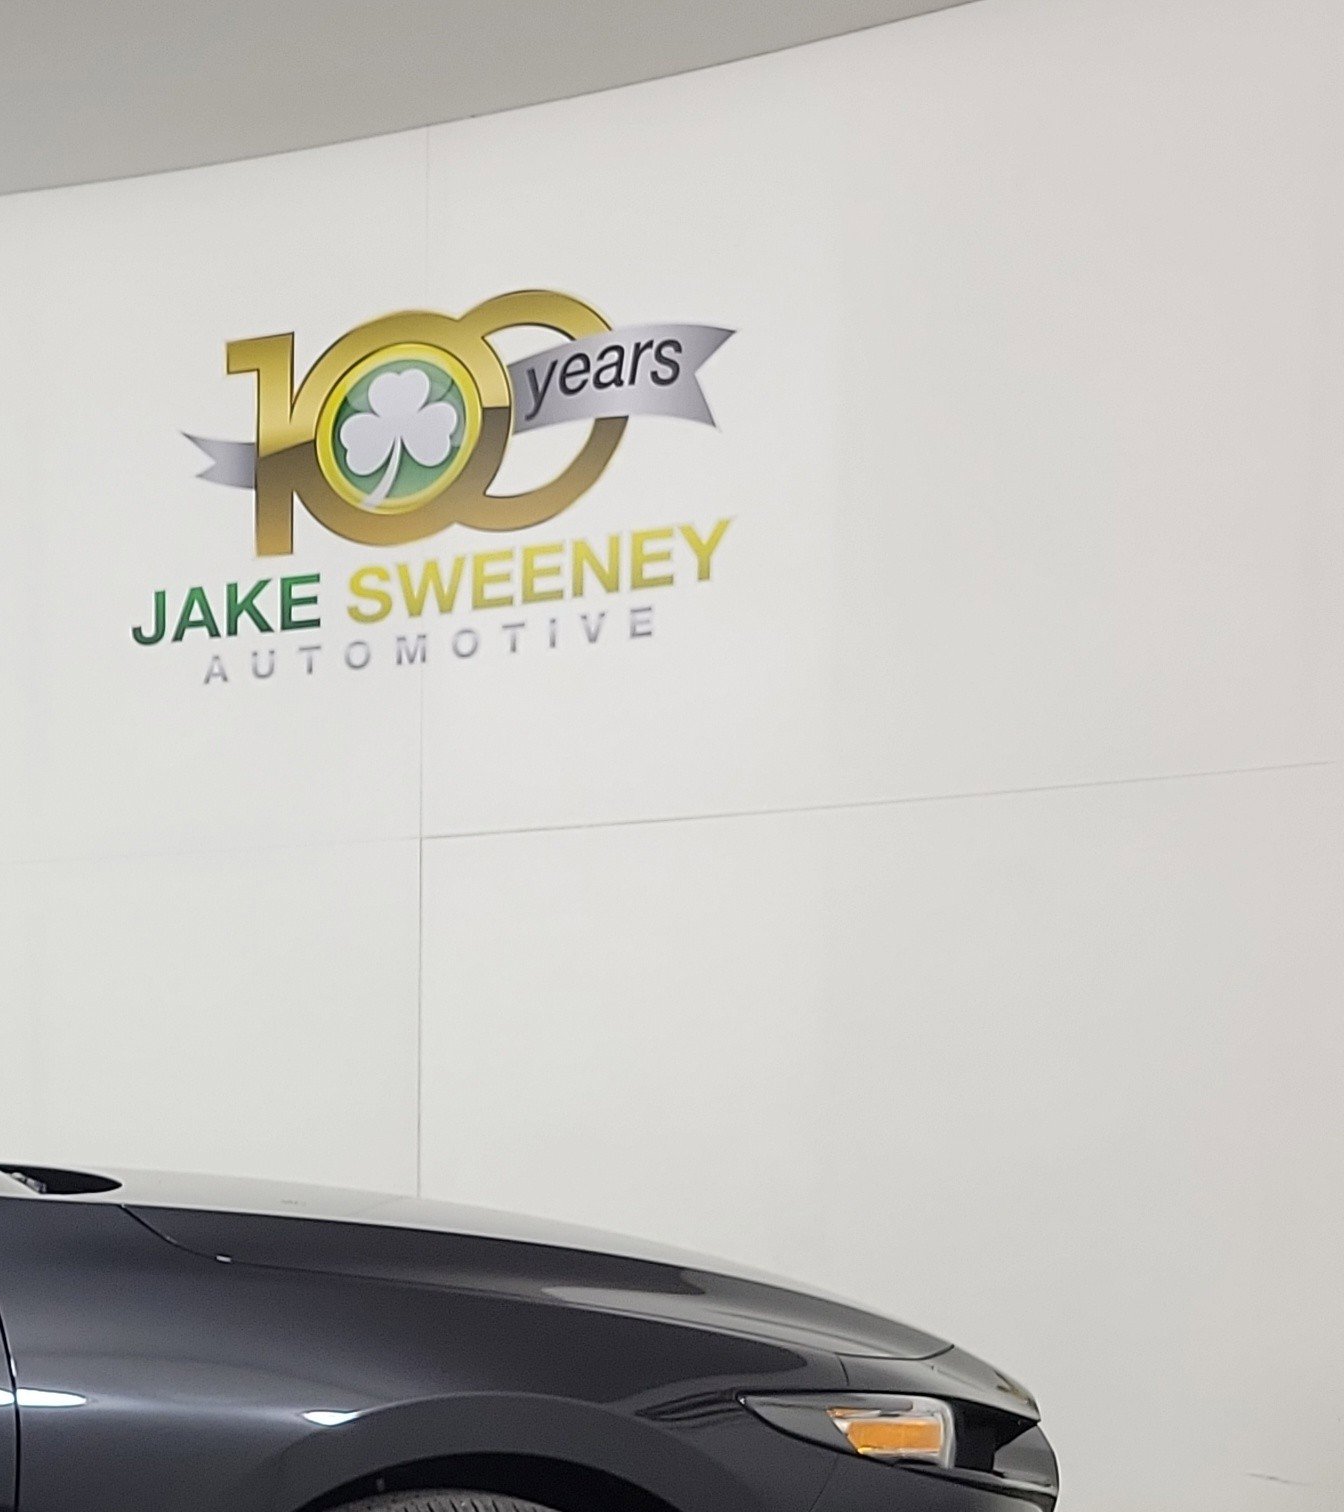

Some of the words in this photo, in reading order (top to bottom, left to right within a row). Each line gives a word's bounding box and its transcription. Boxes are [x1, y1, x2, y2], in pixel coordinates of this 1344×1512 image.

[226, 288, 629, 558] 100
[524, 337, 683, 421] years
[130, 572, 322, 646] JAKE
[345, 517, 731, 626] SWEENEY
[203, 605, 655, 685] AUTOMOTIVE
